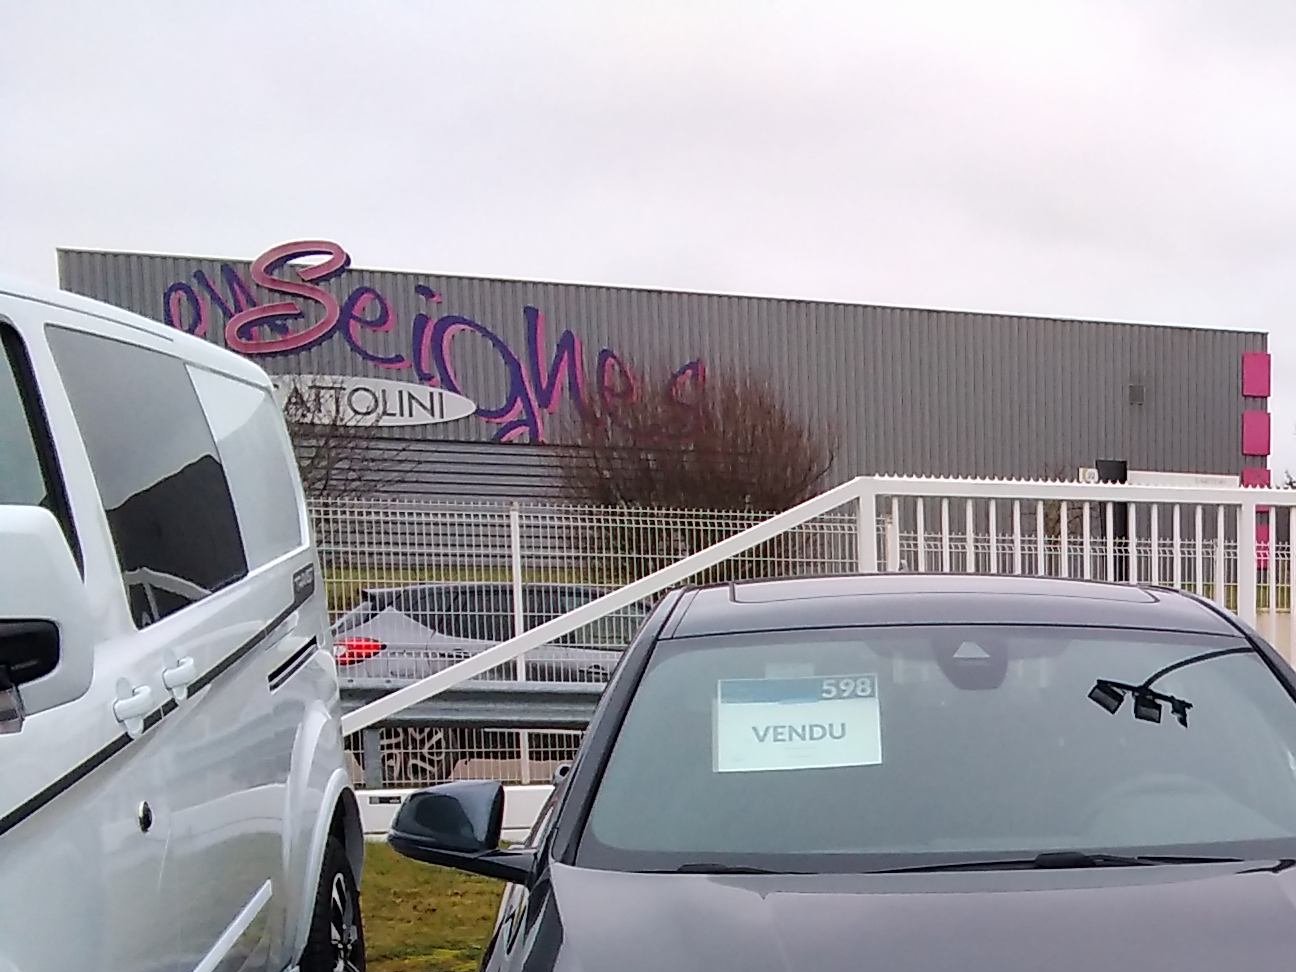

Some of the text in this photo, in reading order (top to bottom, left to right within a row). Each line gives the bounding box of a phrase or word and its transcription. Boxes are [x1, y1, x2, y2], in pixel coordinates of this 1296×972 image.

[273, 382, 445, 422] ATTOLINI
[821, 677, 872, 699] 598
[751, 722, 846, 743] VENDU
